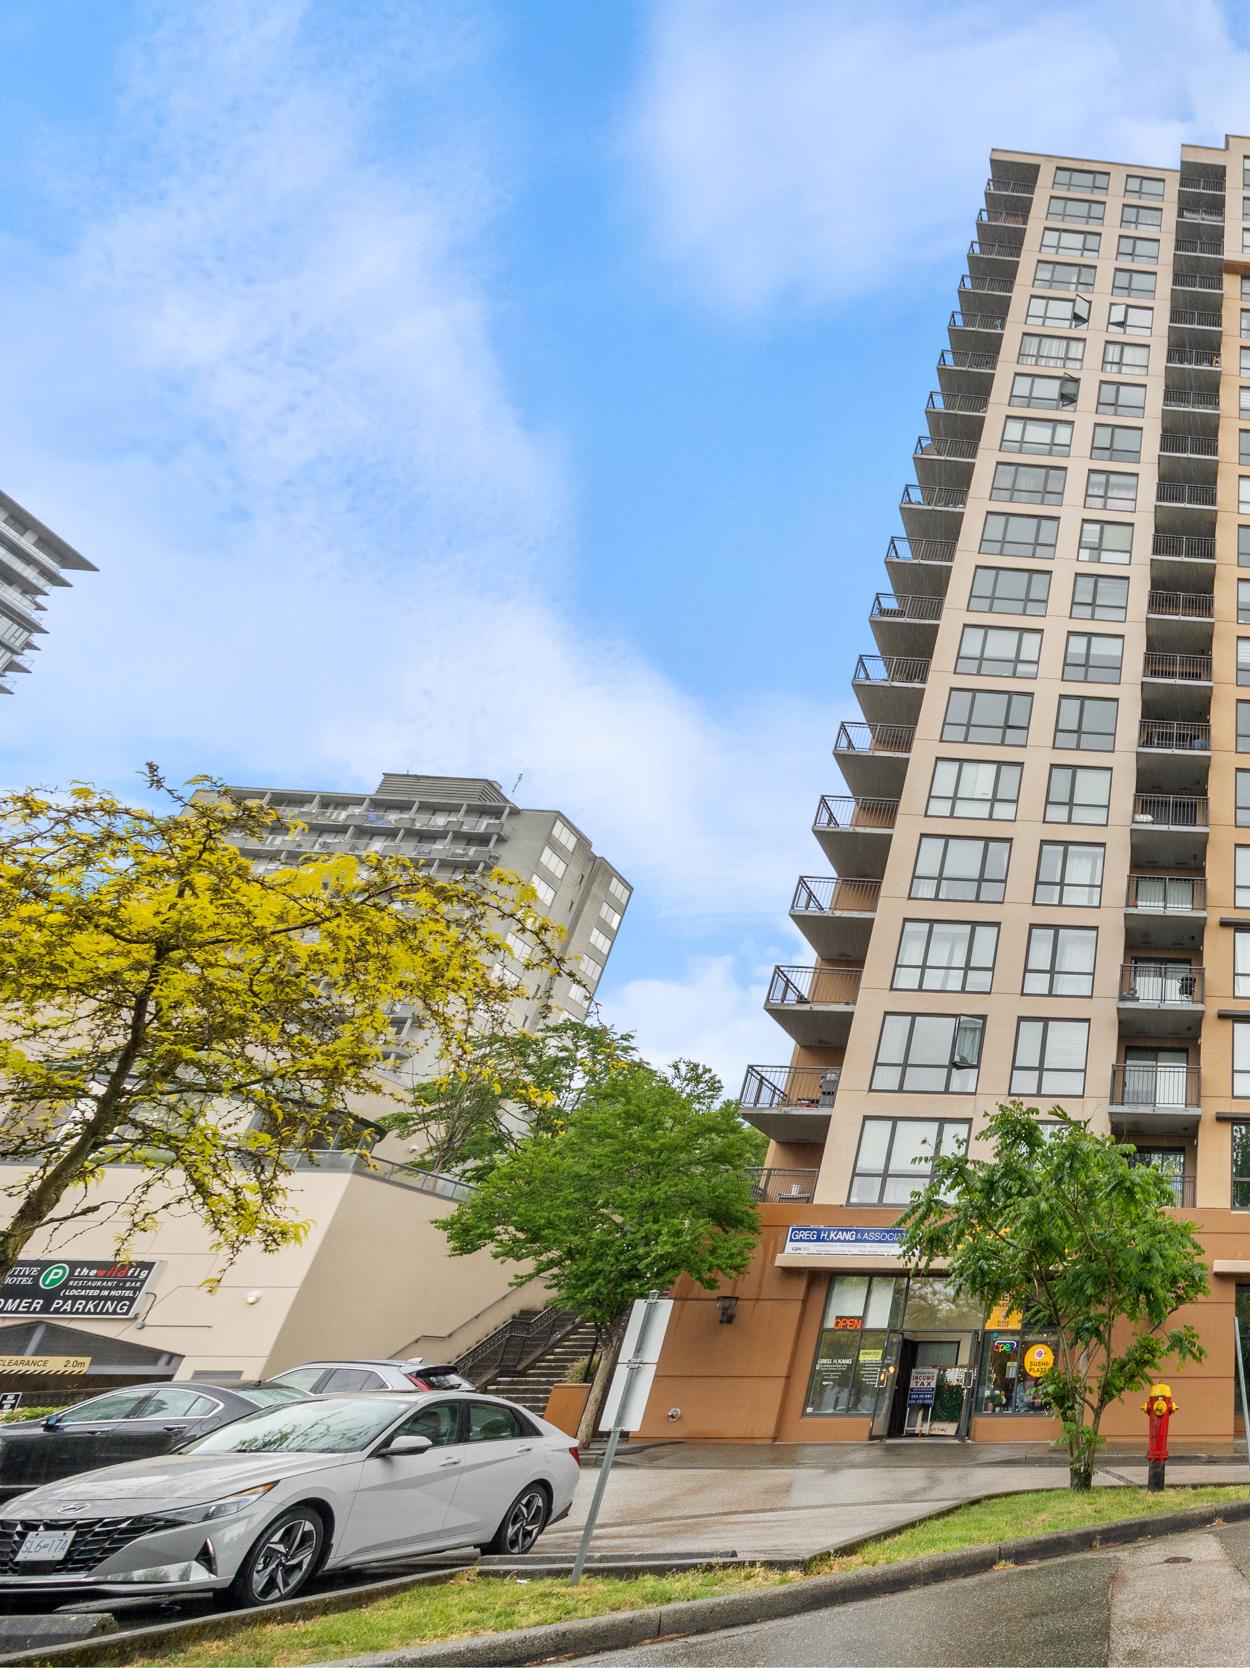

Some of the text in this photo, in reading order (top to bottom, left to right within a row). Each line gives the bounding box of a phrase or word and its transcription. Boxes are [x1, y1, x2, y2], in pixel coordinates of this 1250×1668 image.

[791, 1230, 817, 1240] GREG
[856, 1232, 861, 1240] &
[861, 1232, 905, 1240] ASSOCI
[50, 1300, 130, 1313] PARKING
[833, 1318, 862, 1329] OPEN
[63, 1359, 86, 1368] 2.0m
